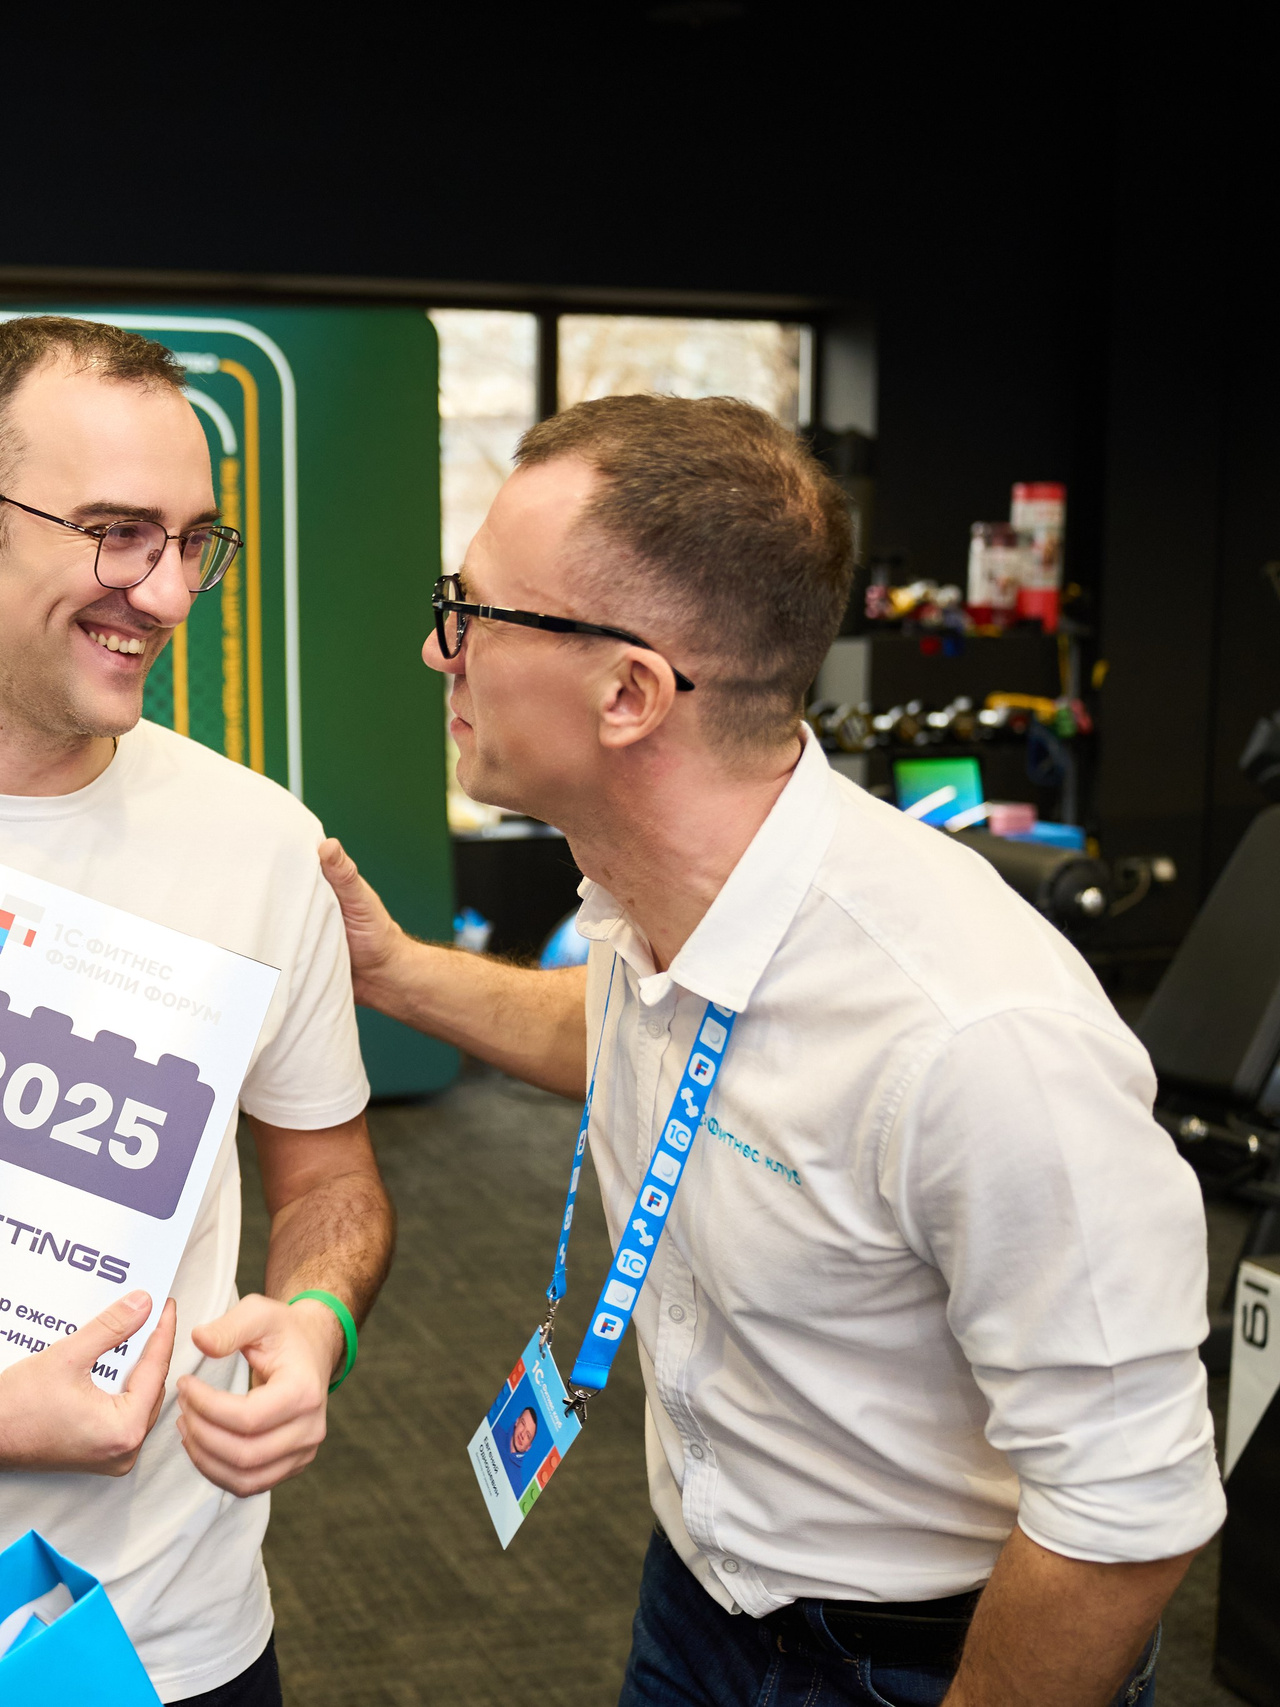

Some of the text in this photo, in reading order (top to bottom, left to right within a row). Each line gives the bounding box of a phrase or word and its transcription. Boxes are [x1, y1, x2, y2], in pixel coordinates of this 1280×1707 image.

[45, 949, 222, 1026] ФЭМИЛИ ФОРУМ
[765, 1155, 802, 1186] клуб
